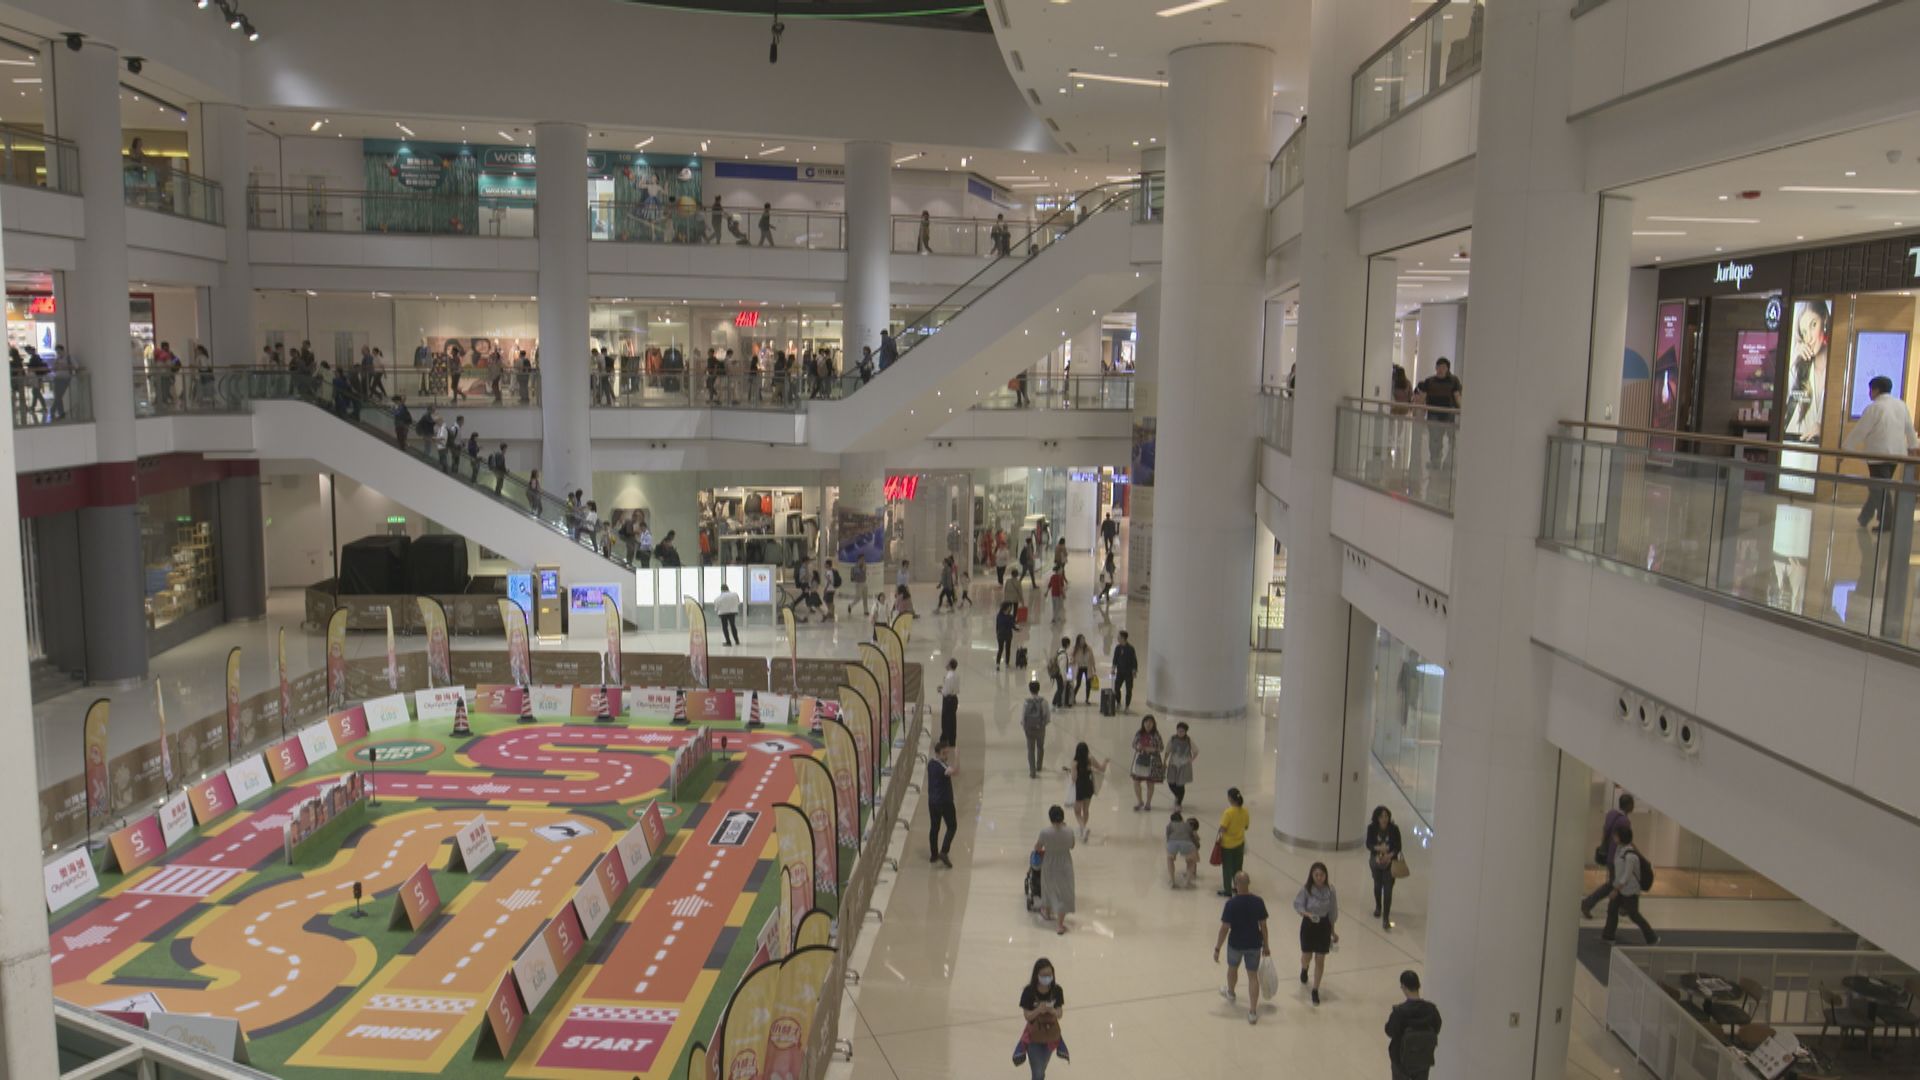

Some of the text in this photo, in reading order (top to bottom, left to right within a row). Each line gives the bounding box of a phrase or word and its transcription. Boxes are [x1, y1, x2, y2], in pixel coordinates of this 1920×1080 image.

[1714, 260, 1753, 291] Jurlique
[883, 475, 918, 501] H&M
[345, 1024, 443, 1041] FINISH
[562, 1036, 654, 1052] START
